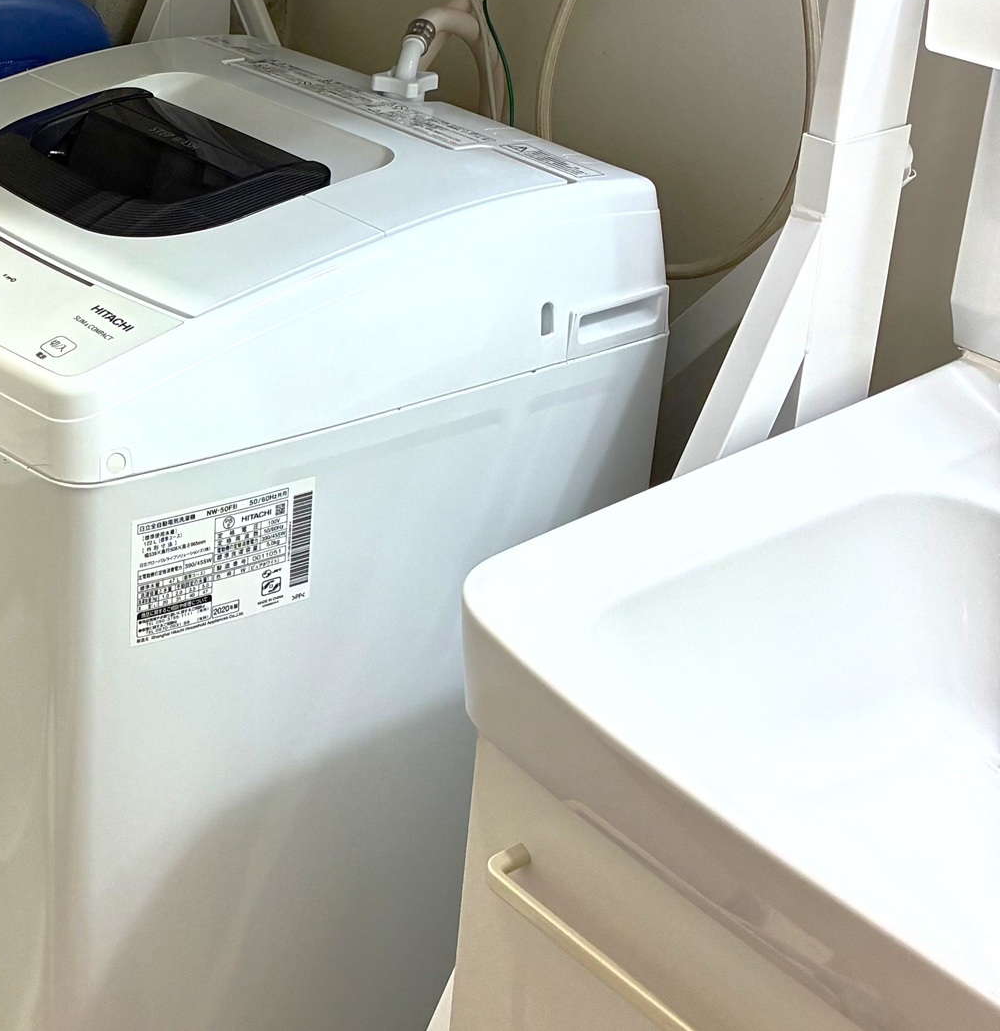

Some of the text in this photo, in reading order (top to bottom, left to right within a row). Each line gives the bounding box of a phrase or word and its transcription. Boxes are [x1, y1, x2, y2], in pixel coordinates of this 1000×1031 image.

[90, 304, 135, 333] HITACHI
[88, 323, 115, 342] COMPACT
[139, 514, 196, 532] 日立全自動電気洗濯機
[241, 509, 272, 523] HITACHI
[252, 549, 282, 561] 0011051
[185, 558, 212, 569] 390/455W
